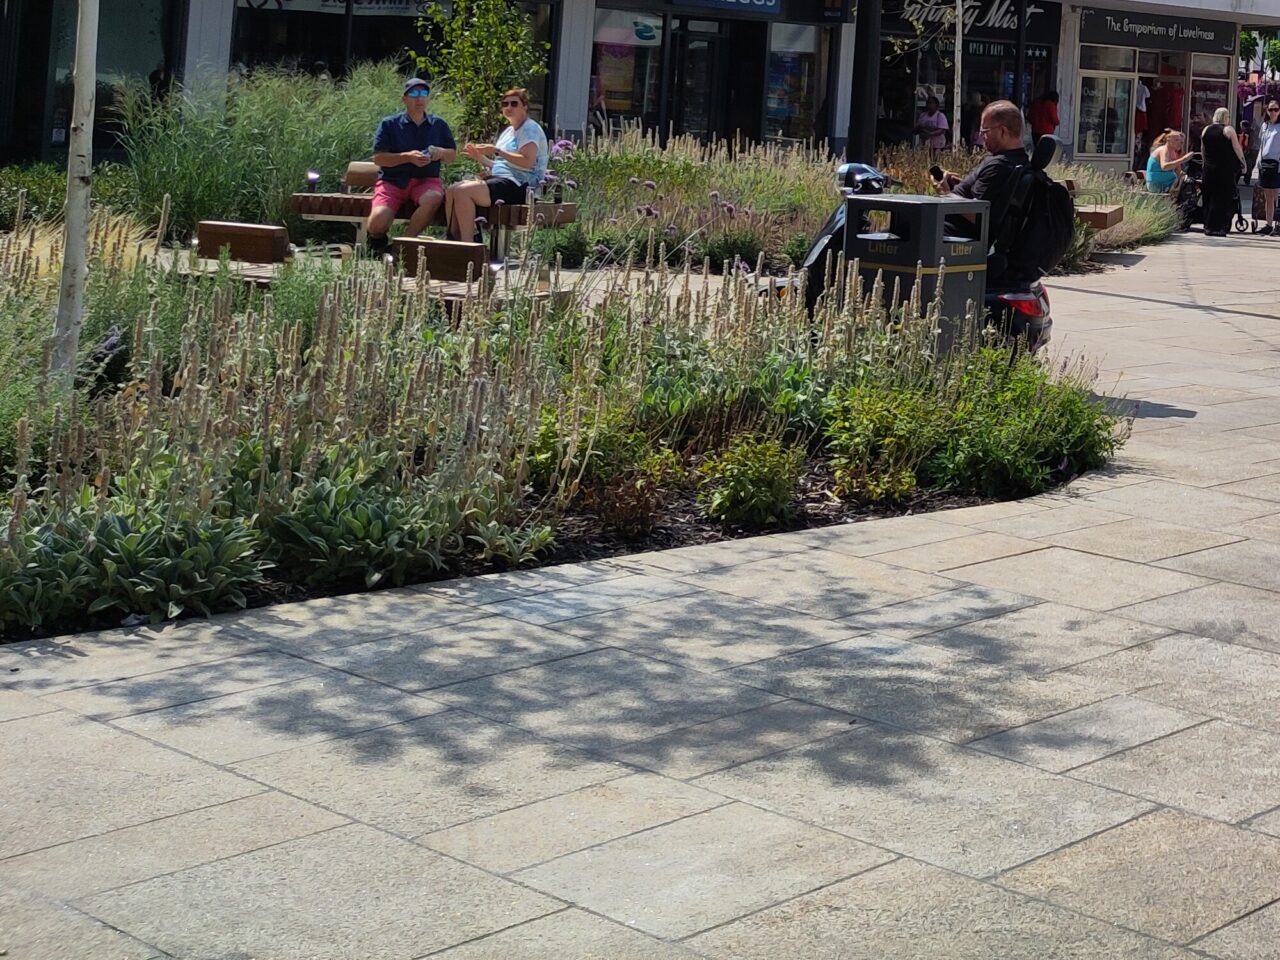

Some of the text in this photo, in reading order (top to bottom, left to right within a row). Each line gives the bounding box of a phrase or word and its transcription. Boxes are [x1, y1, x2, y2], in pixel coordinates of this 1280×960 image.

[1106, 16, 1121, 31] The
[1168, 23, 1178, 40] of
[868, 240, 898, 255] Litter
[951, 243, 973, 256] Litter
